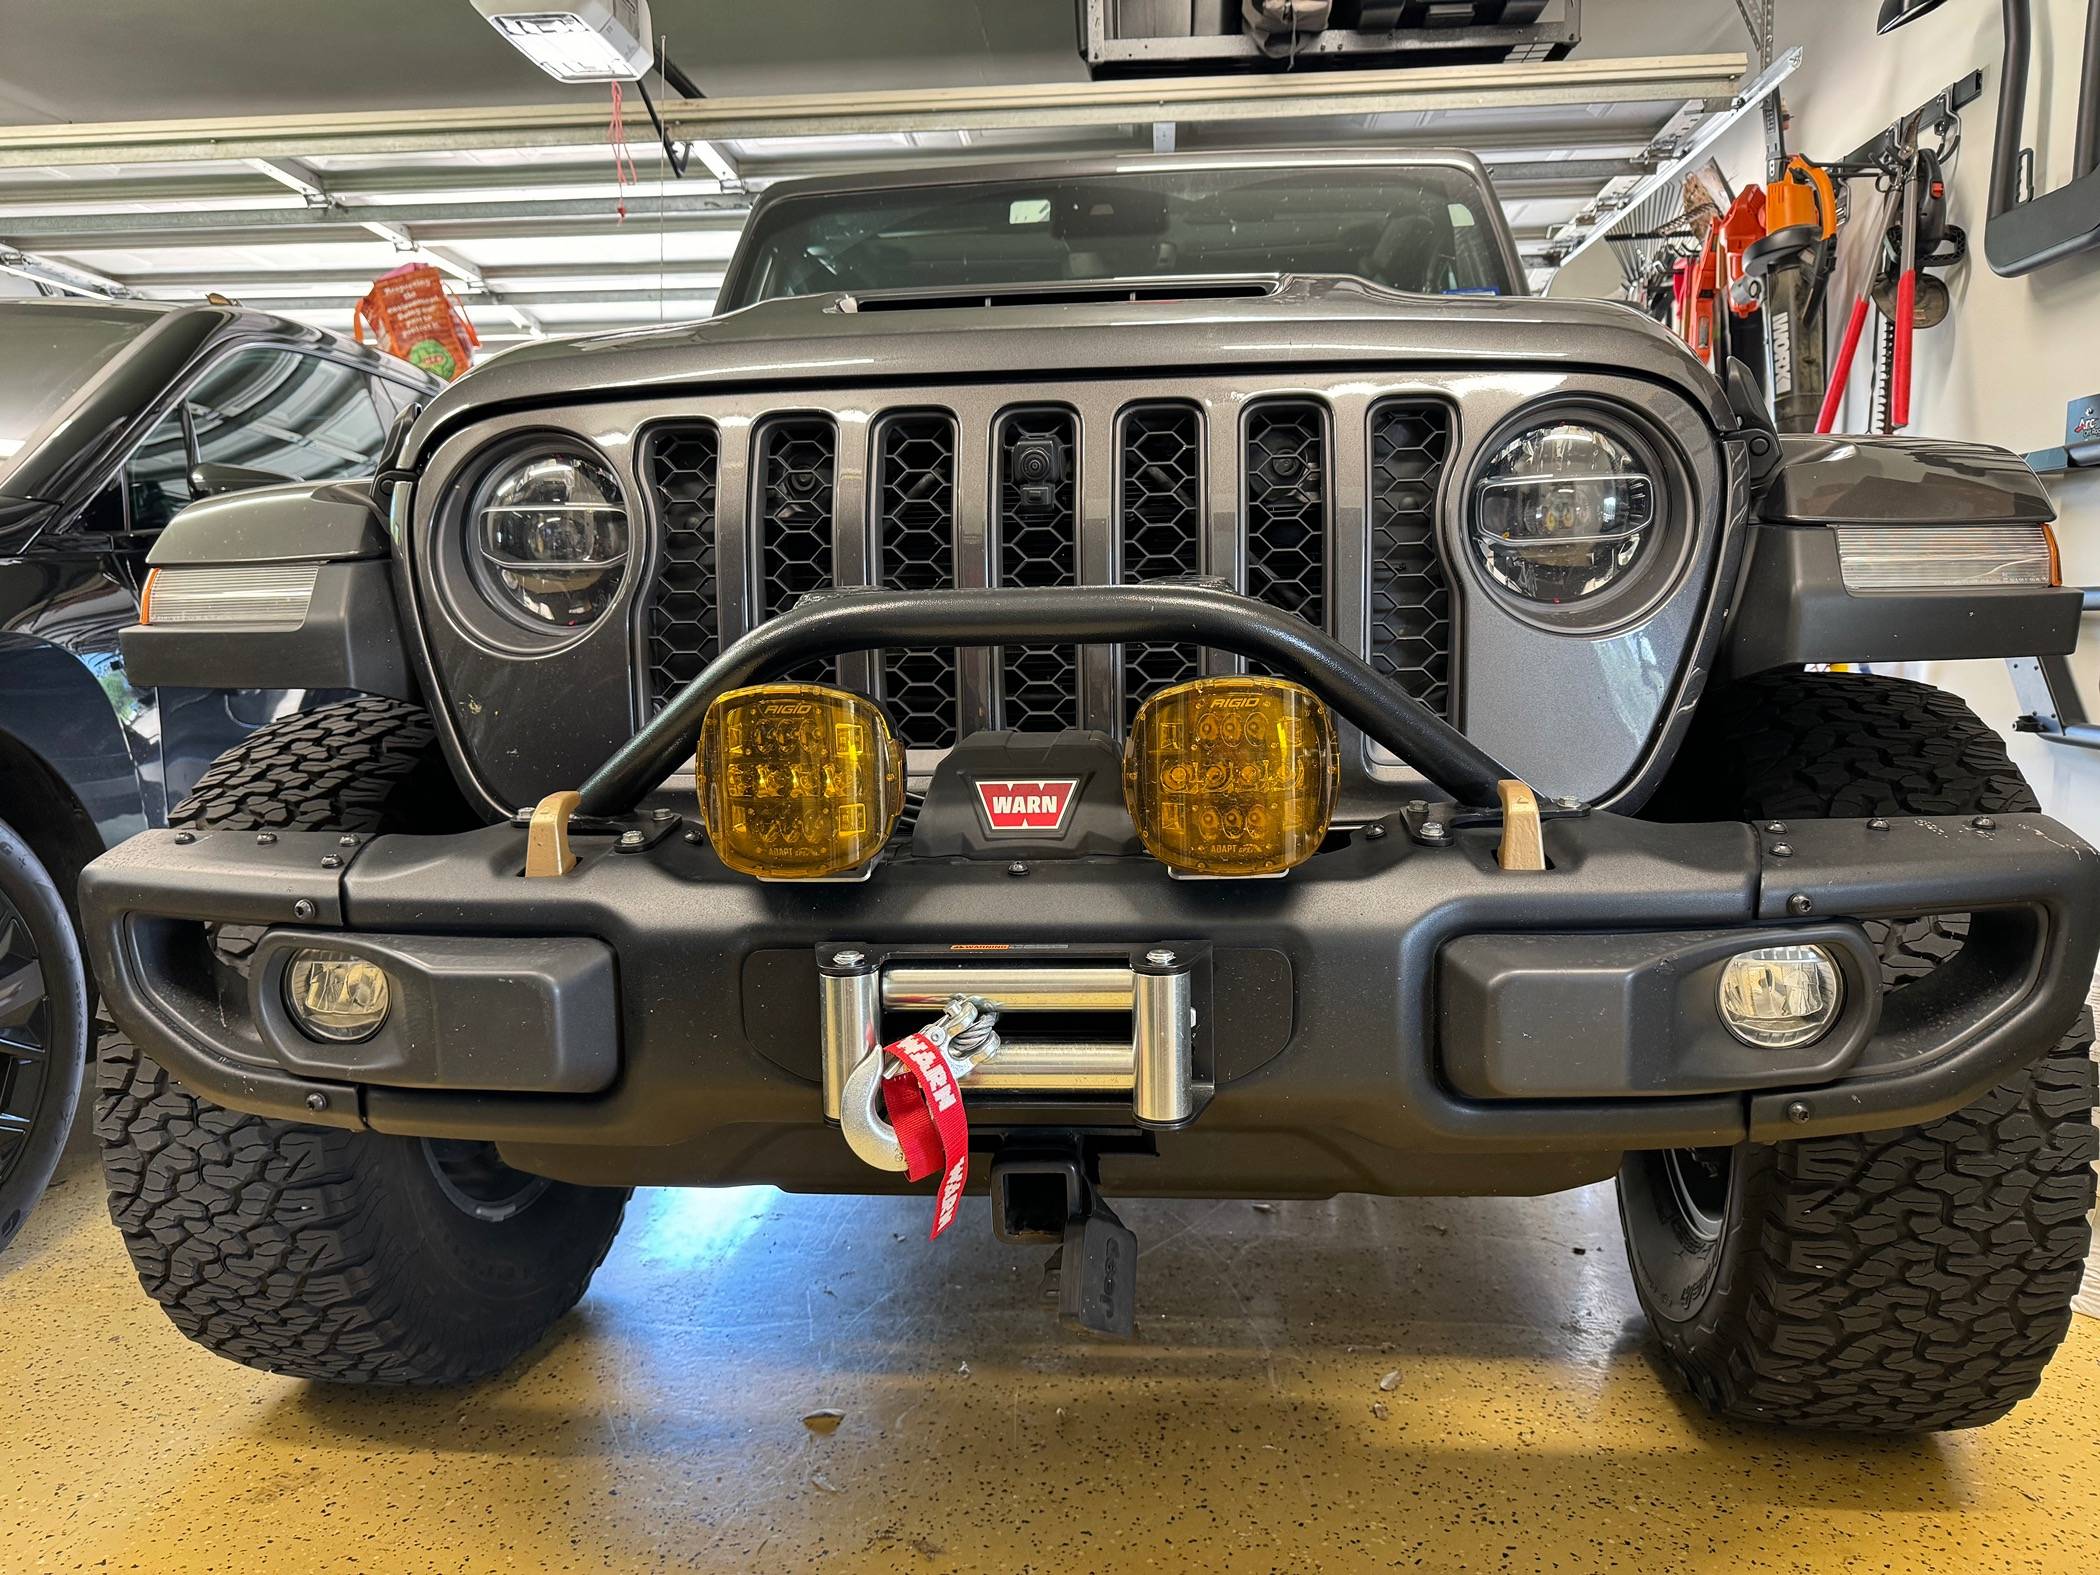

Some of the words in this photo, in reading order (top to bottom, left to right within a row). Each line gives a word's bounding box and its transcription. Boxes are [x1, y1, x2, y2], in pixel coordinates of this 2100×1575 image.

[764, 704, 812, 714] RIGID
[1210, 698, 1260, 708] RIGID
[992, 795, 1057, 814] WARN
[1211, 844, 1237, 854] ADAPT
[896, 1035, 957, 1113] WARN
[937, 1155, 965, 1232] WARN
